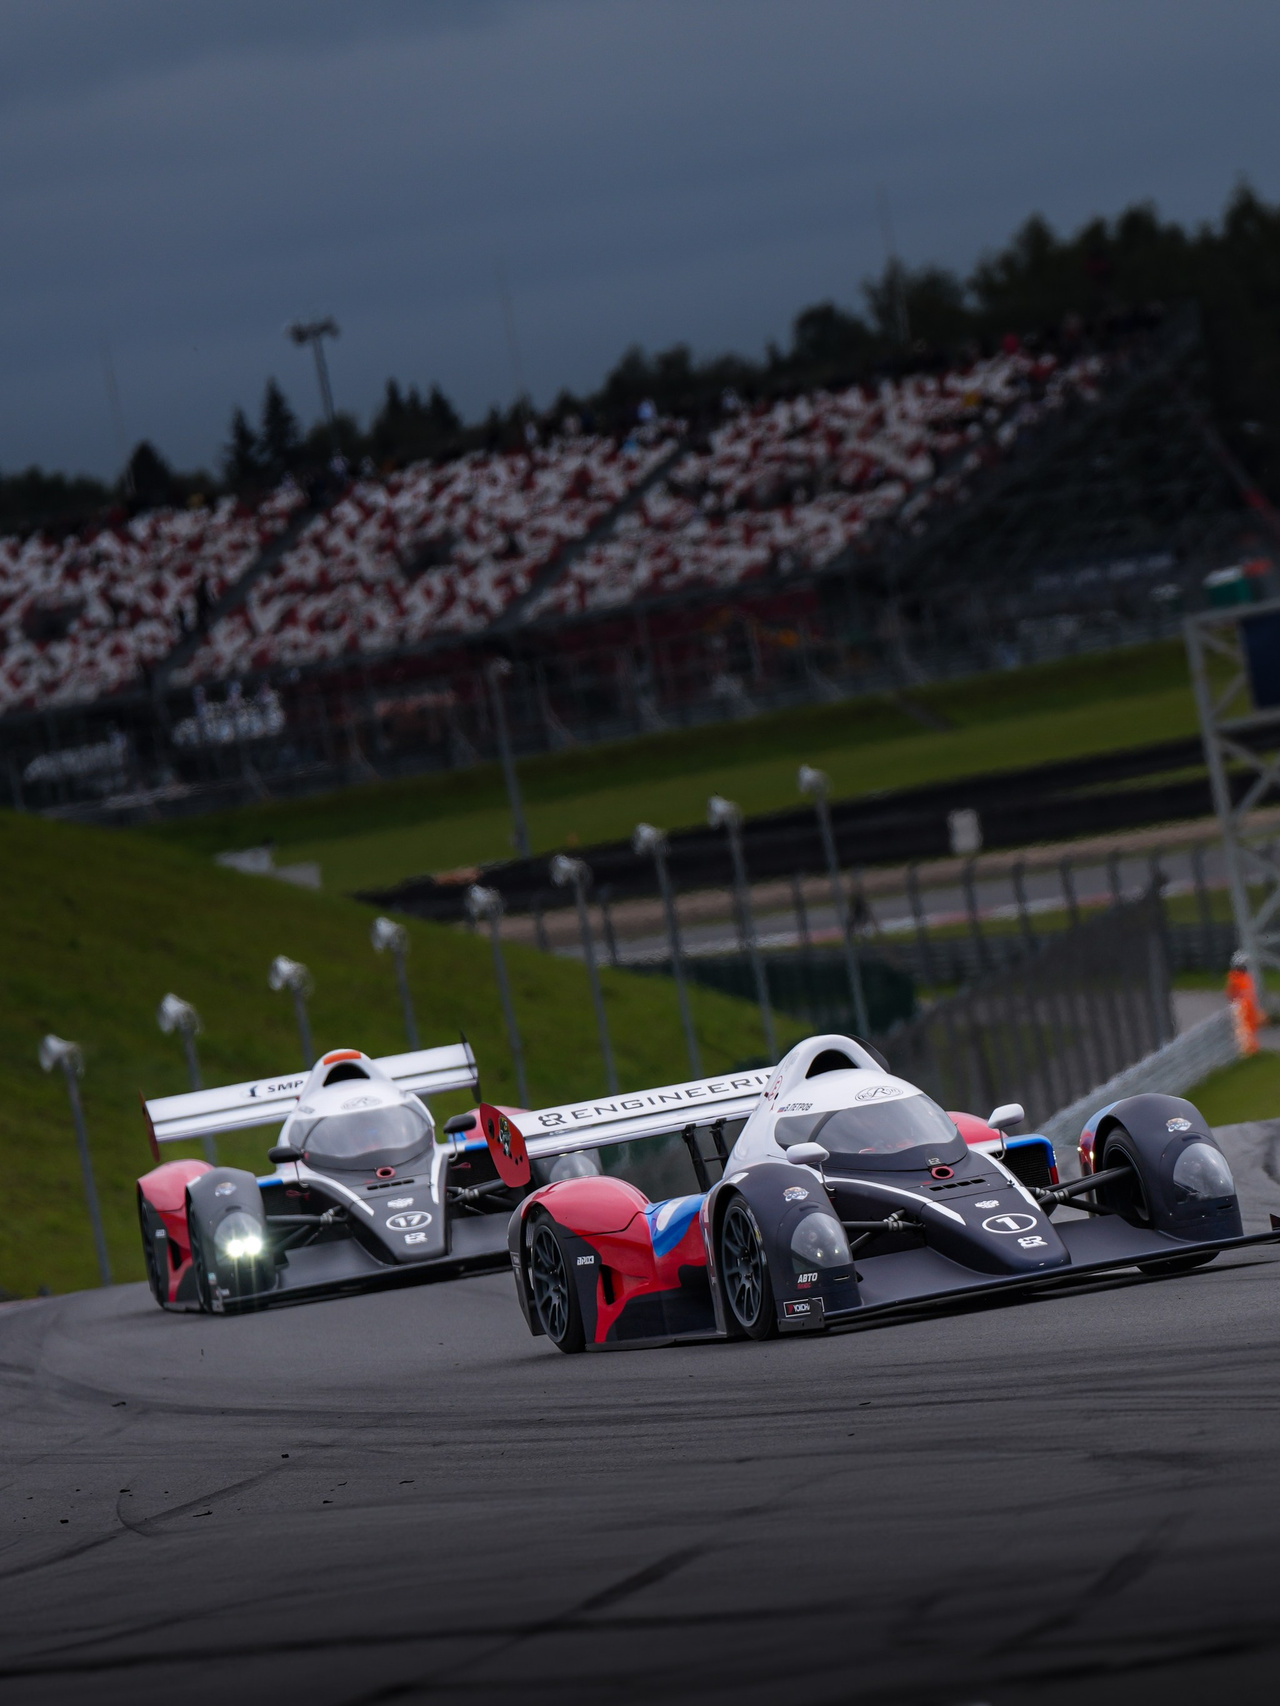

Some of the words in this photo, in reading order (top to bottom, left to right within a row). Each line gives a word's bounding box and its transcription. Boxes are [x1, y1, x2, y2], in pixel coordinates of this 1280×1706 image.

[267, 1080, 304, 1093] SMP
[571, 1074, 772, 1120] ENGINEERI
[394, 1213, 422, 1228] 17
[995, 1216, 1021, 1230] 1
[797, 1272, 818, 1283] АВТО
